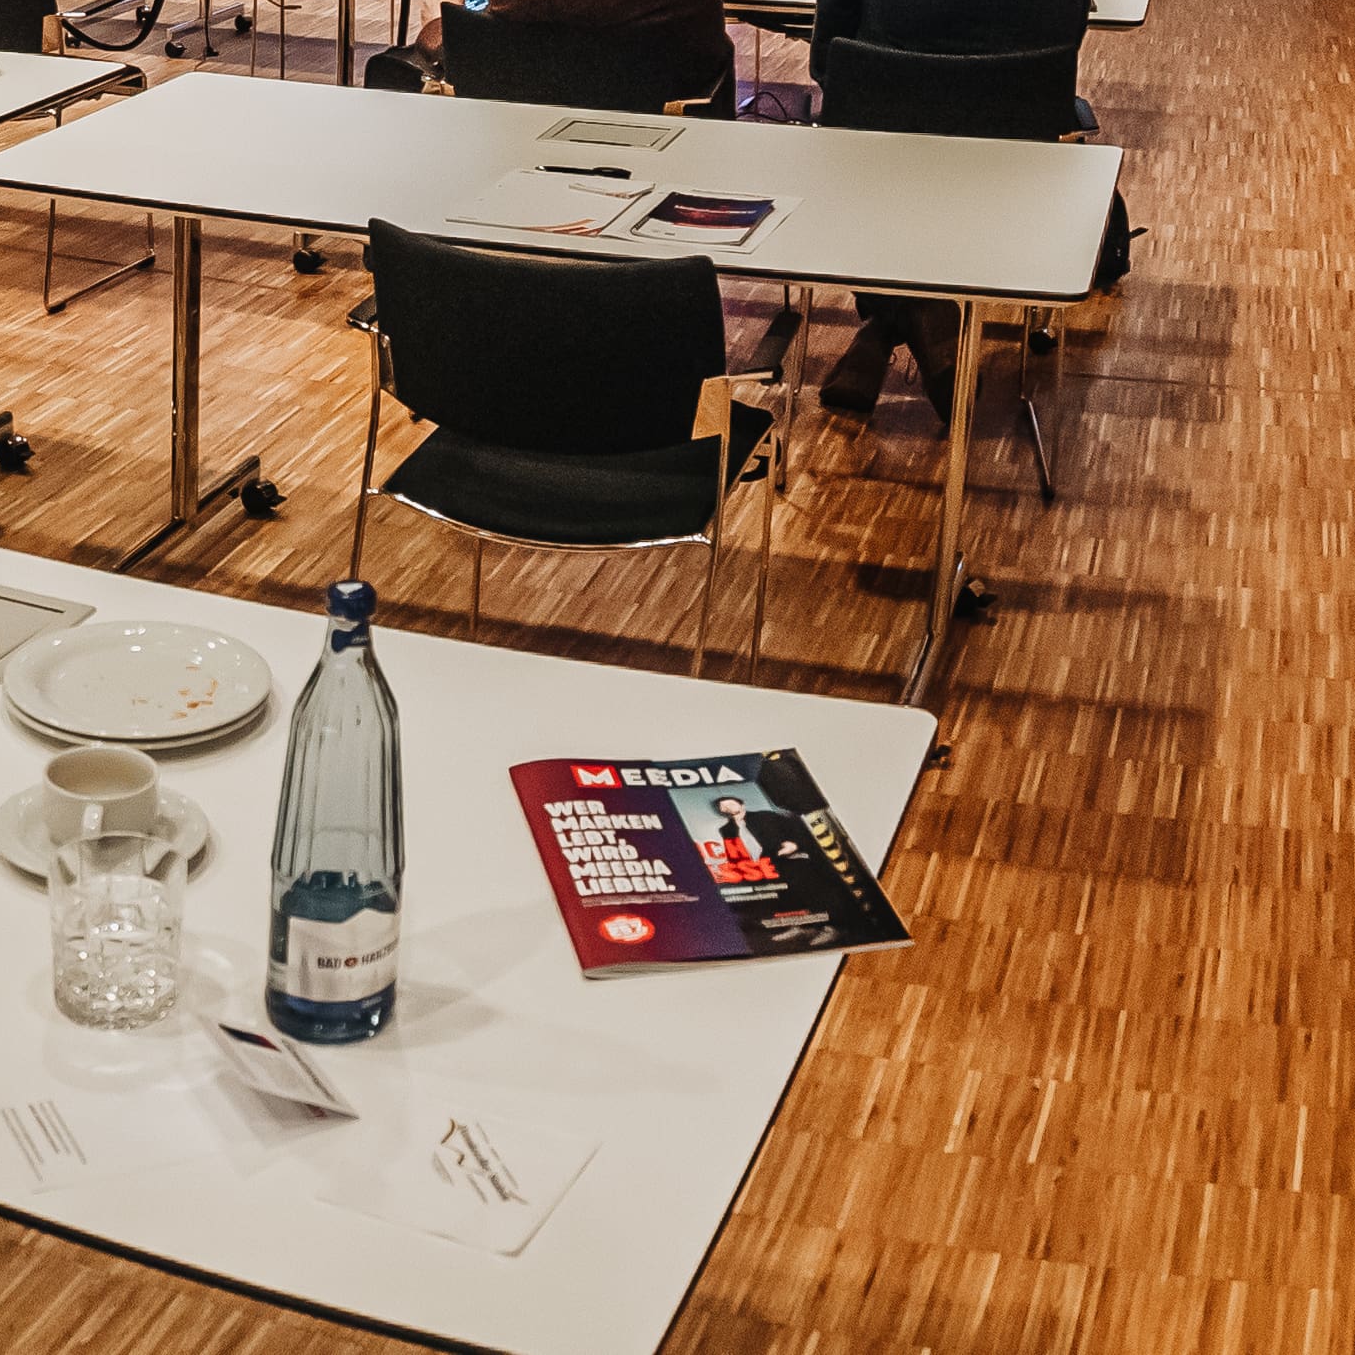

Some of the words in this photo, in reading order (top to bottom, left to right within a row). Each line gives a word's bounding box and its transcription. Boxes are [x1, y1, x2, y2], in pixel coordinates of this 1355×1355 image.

[576, 764, 746, 788] MEEDIA
[544, 799, 607, 817] WER
[551, 814, 663, 833] MARKEN
[562, 845, 639, 864] WIRD
[569, 859, 673, 880] MEEDIA
